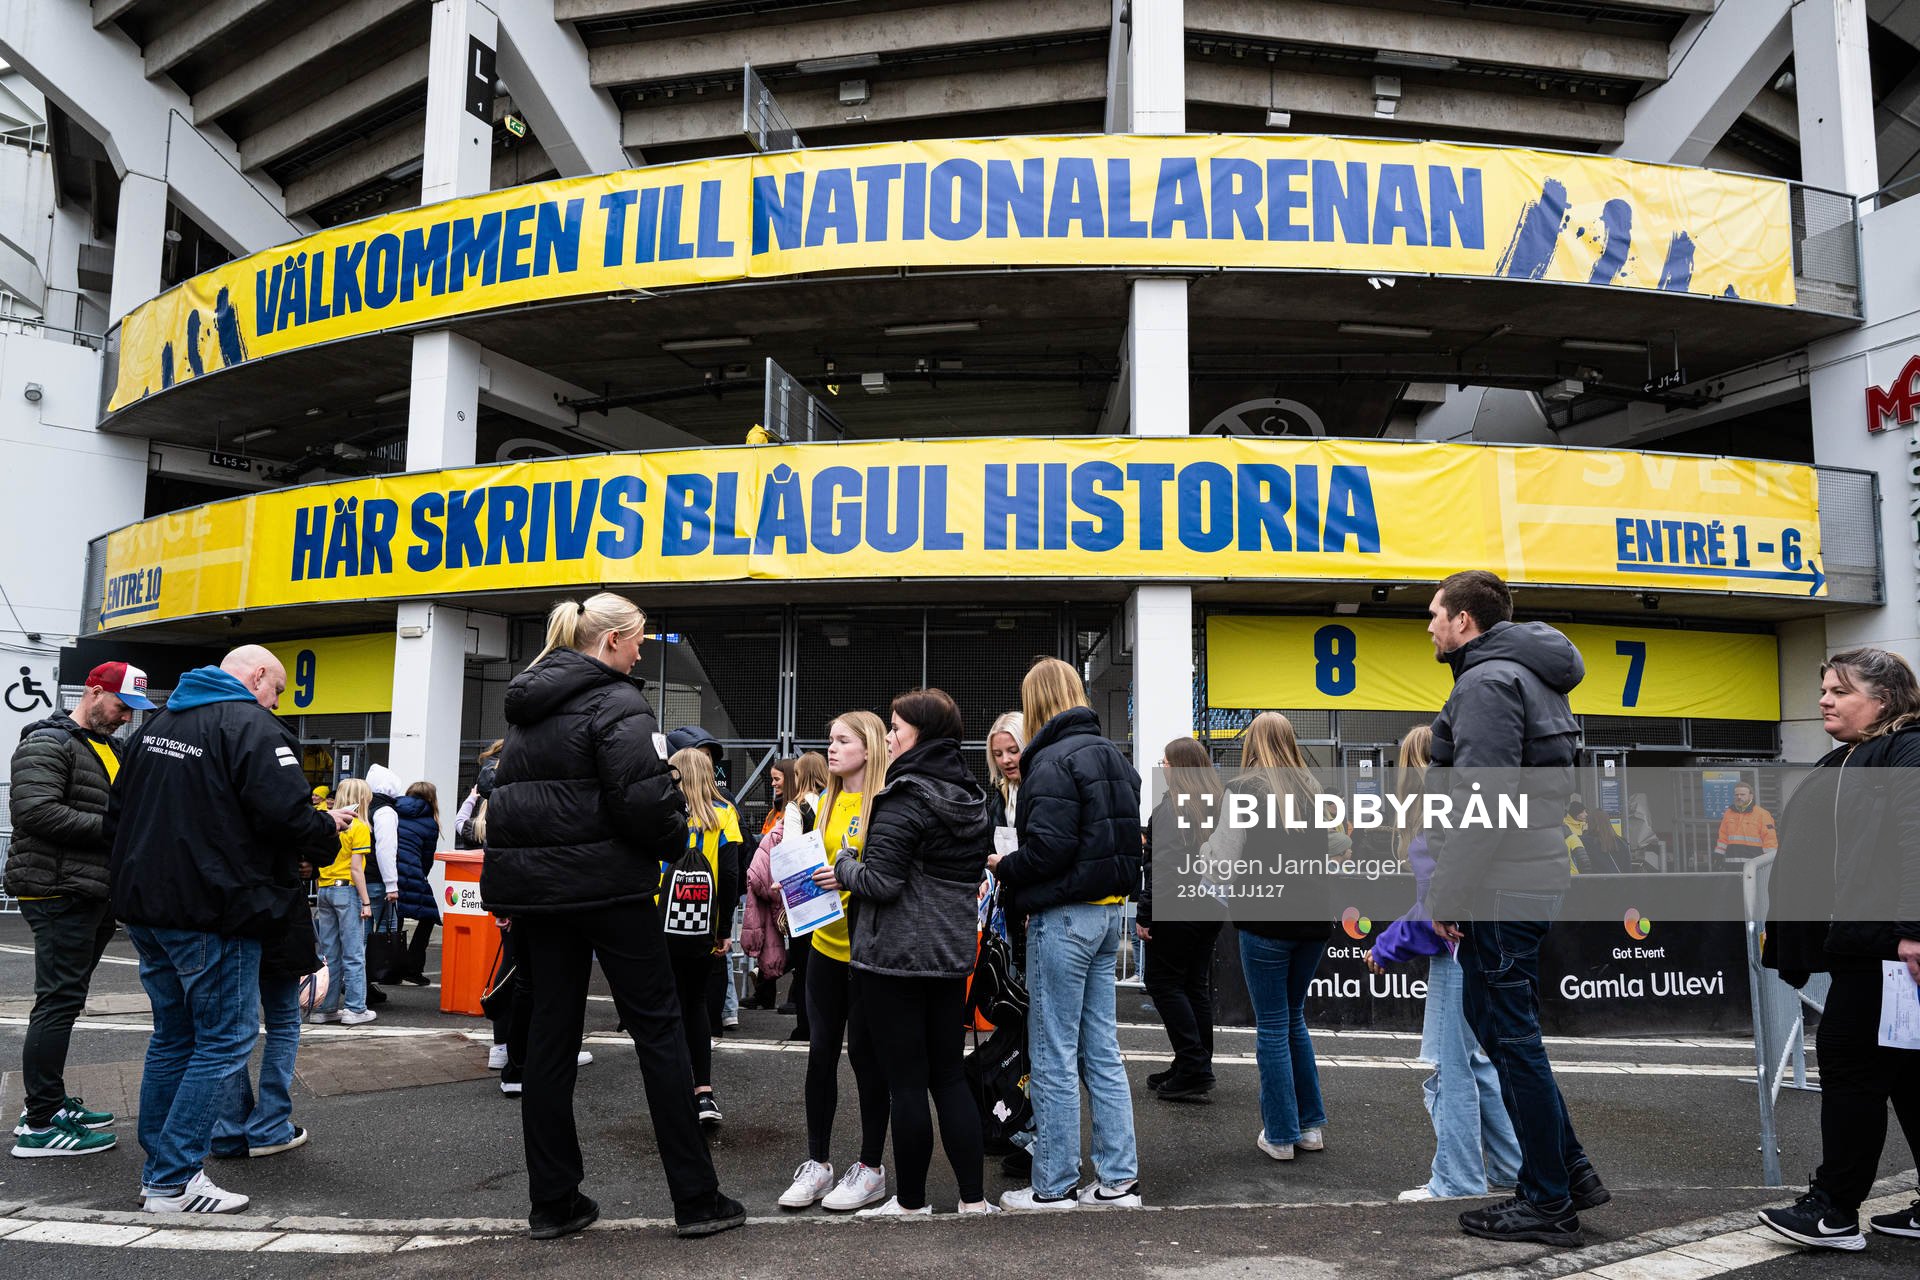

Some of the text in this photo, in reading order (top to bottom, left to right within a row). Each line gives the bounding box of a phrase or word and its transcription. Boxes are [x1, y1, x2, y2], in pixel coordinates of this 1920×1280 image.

[474, 48, 489, 84] L
[477, 102, 483, 112] 1
[256, 158, 1485, 336] VÄLKOMMEN TILL NATIONALARENAN
[1656, 371, 1680, 389] J1-4
[291, 461, 1381, 581] HÄR SKRIVS BLÅGUL HISTORIA
[1616, 518, 1727, 566] ENTRÉ
[107, 566, 163, 611] ENTRÉ 10
[1314, 624, 1357, 697] 8
[1616, 641, 1646, 707] 7
[294, 649, 316, 708] 9
[156, 737, 203, 757] UTVECKLING
[461, 889, 475, 899] Got
[461, 899, 483, 909] Even
[675, 883, 709, 901] VANS
[1327, 946, 1350, 959] Got
[1612, 946, 1666, 960] Got Event
[1369, 973, 1428, 999] Ulle
[1559, 970, 1725, 1000] Gamla Ullevi
